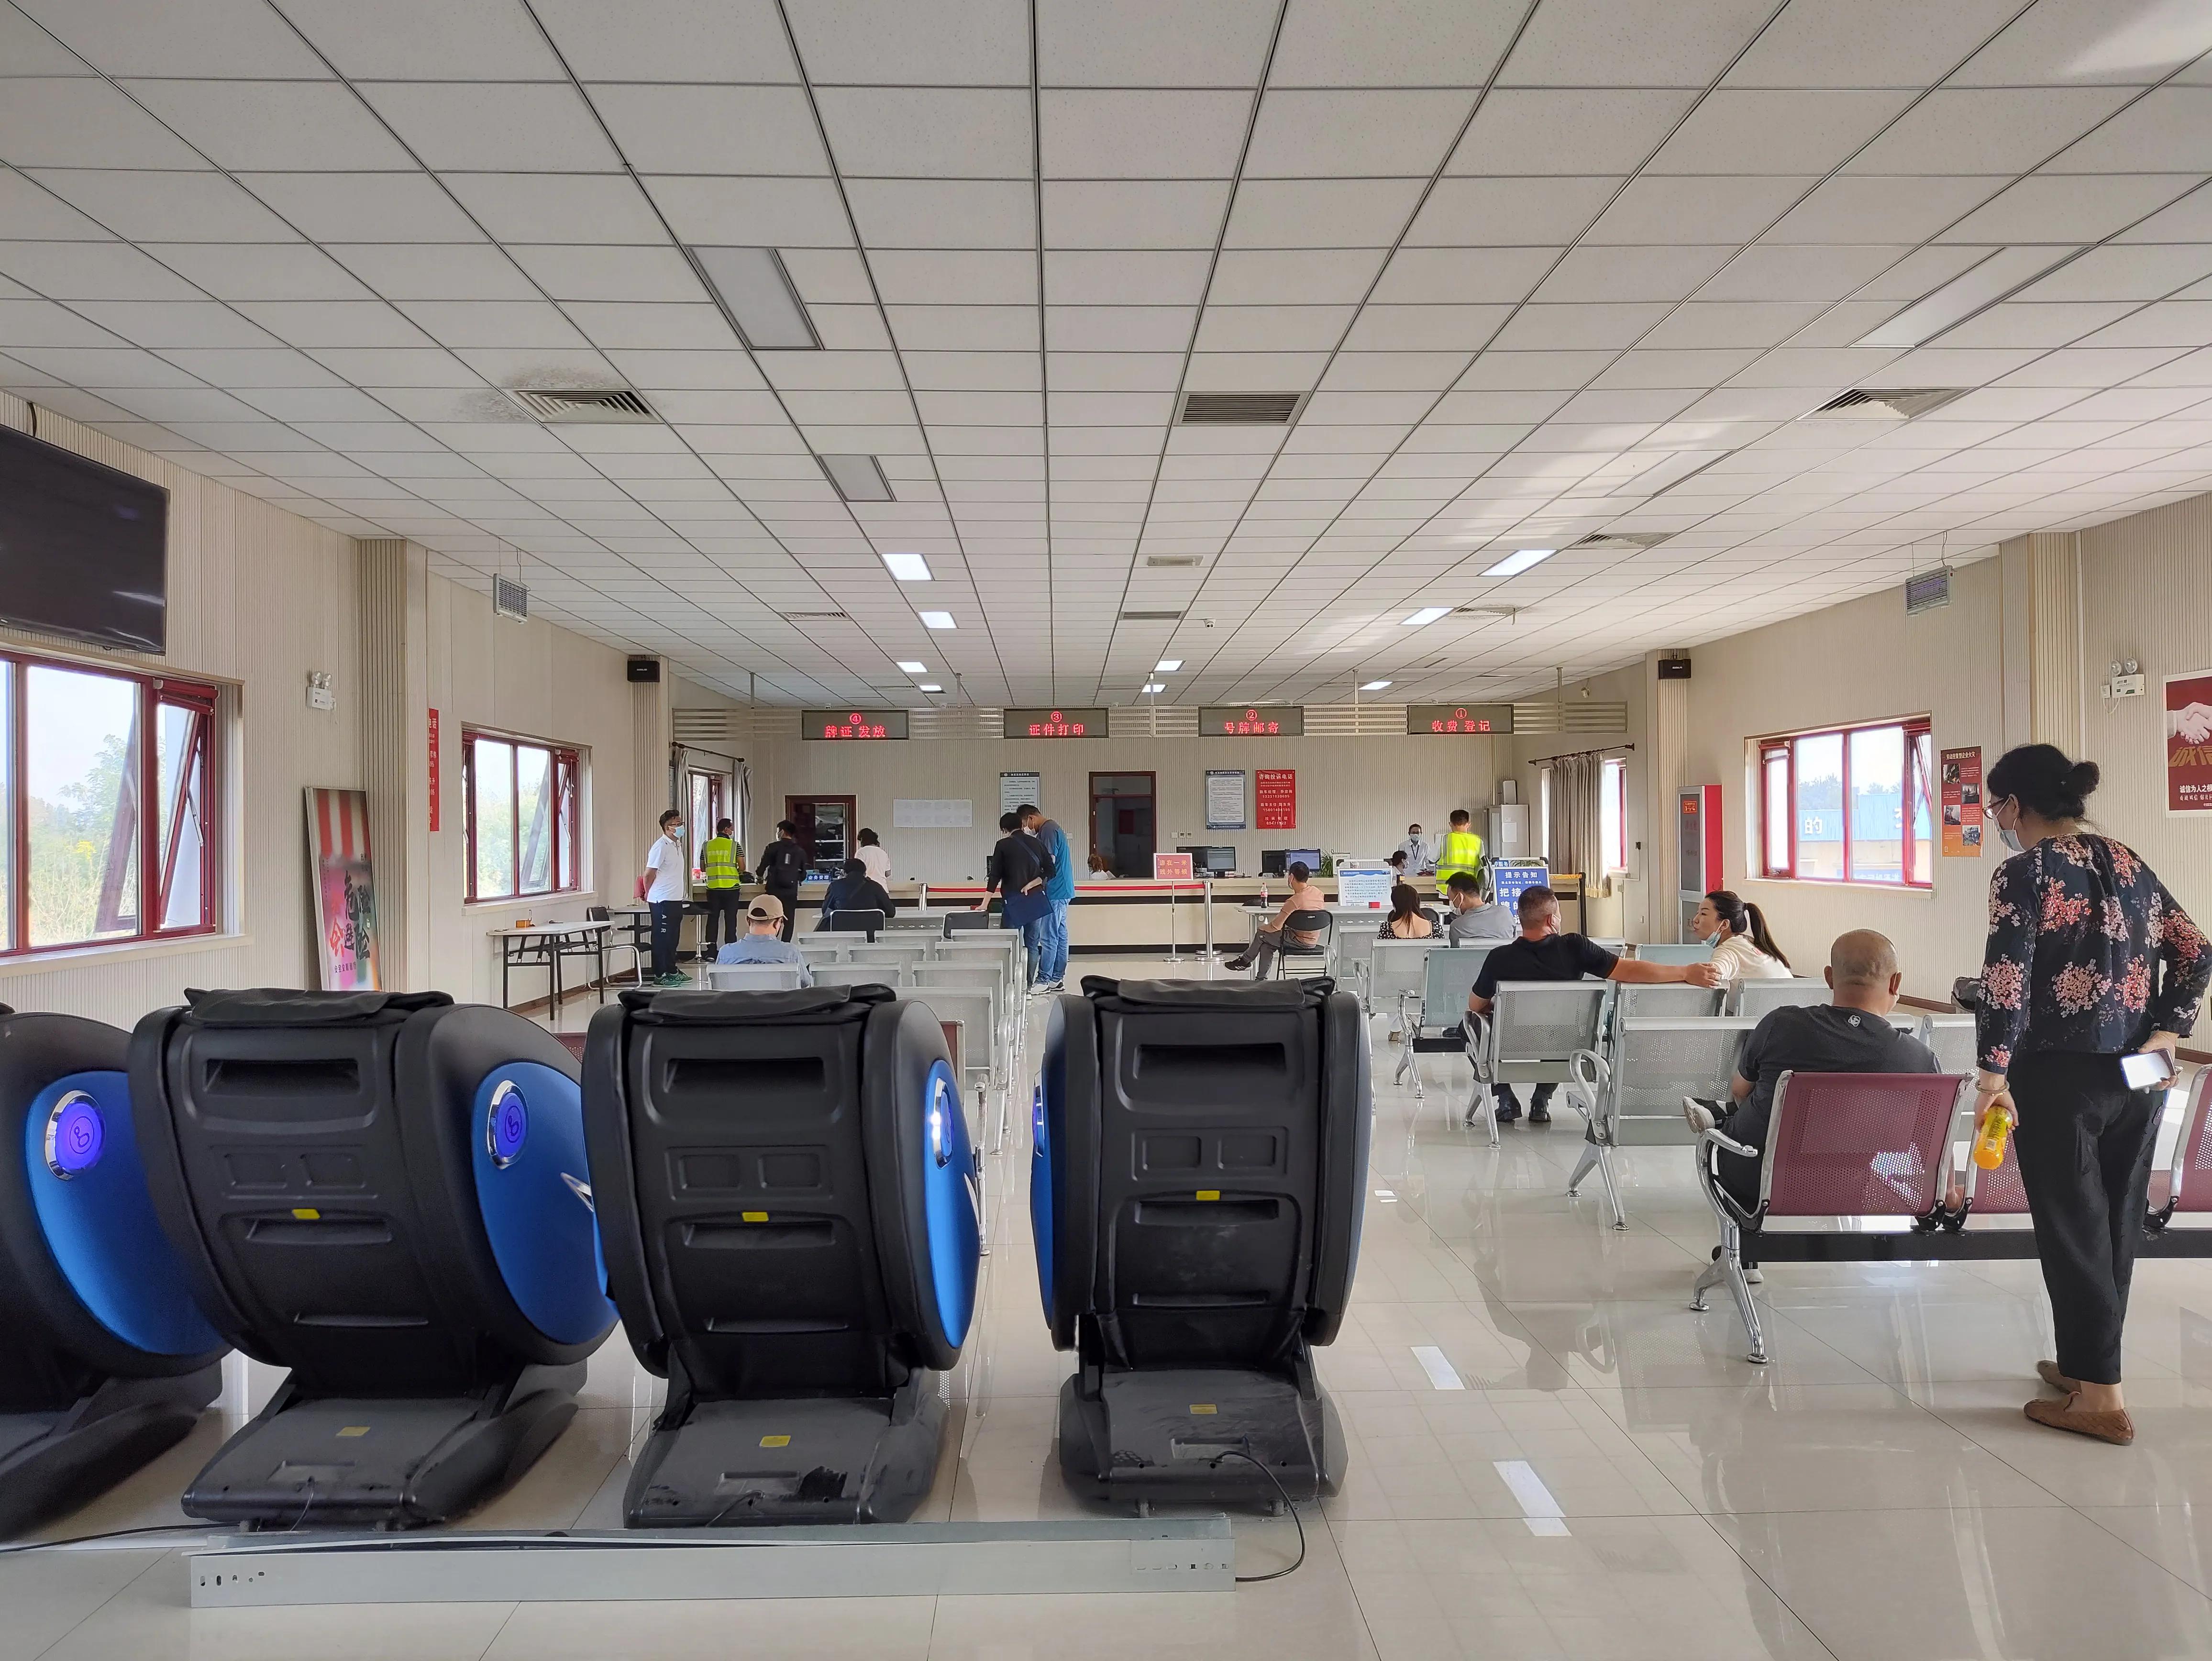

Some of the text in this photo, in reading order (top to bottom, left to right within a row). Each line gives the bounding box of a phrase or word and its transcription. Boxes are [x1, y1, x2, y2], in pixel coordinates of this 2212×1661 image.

[824, 725, 886, 738] 牌证发放
[1029, 723, 1084, 736] 证件打印
[1225, 721, 1279, 734] 号牌邮寄
[1432, 720, 1491, 732] 收费登记
[1804, 816, 1823, 834] 的
